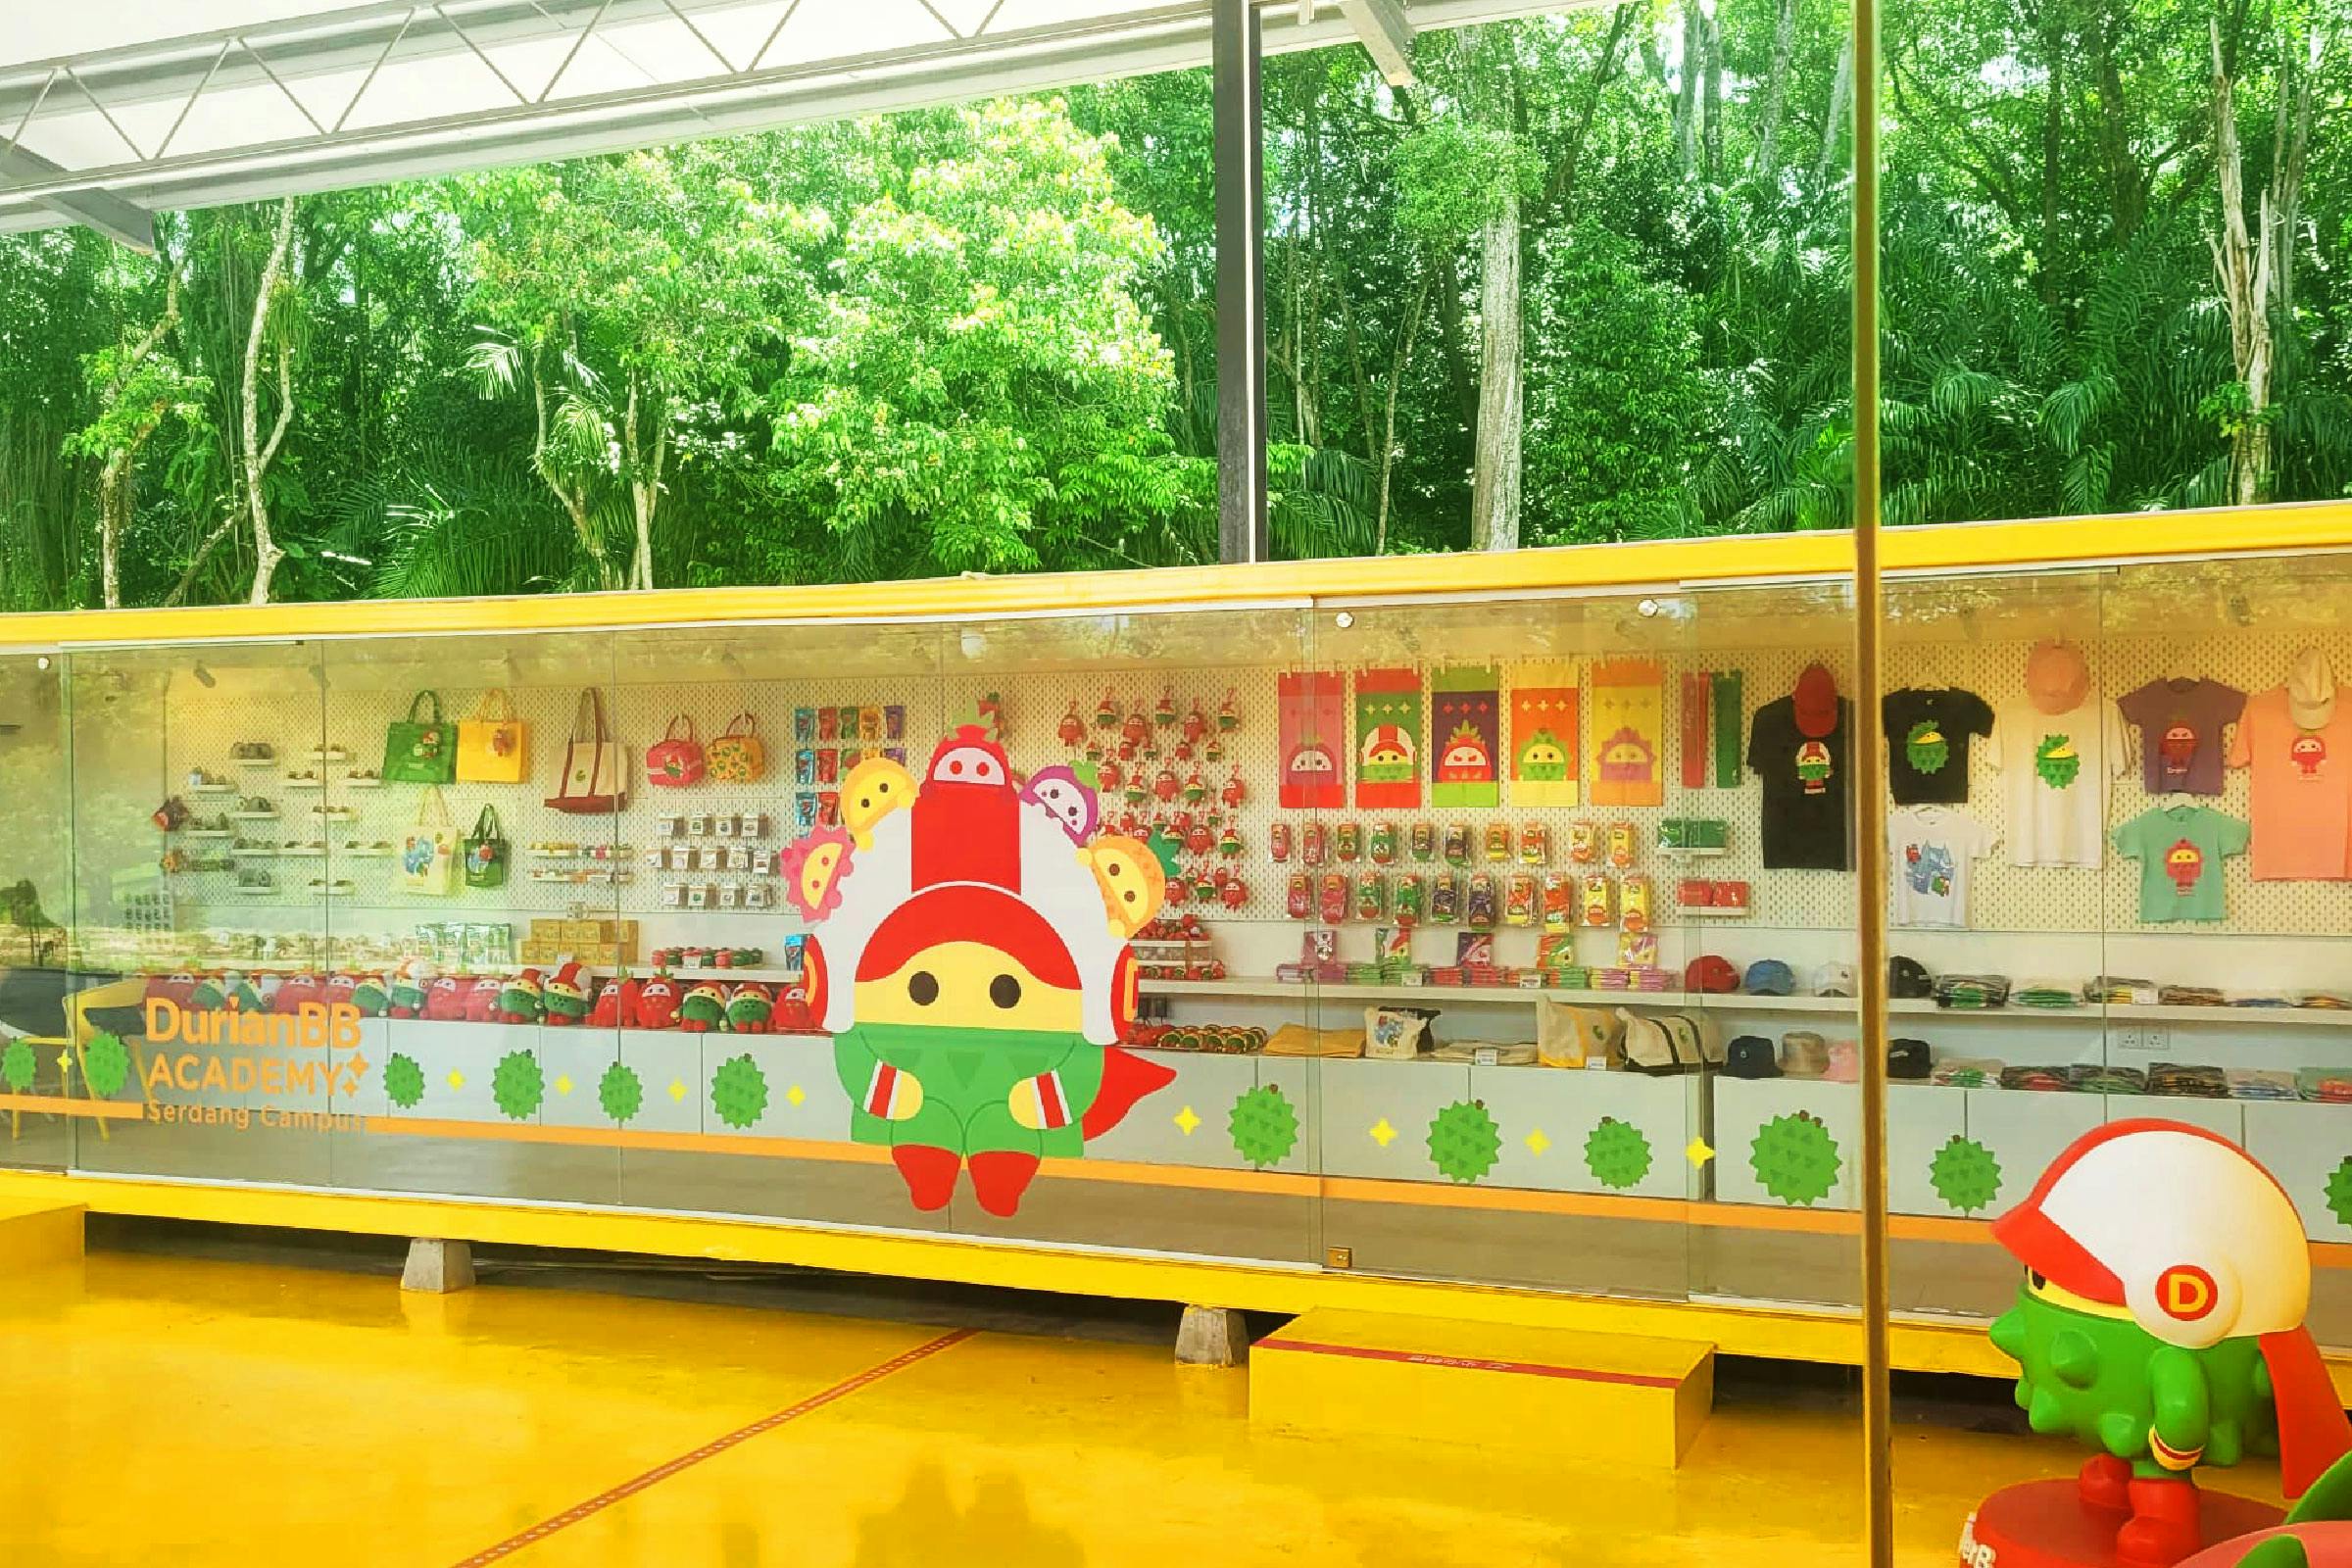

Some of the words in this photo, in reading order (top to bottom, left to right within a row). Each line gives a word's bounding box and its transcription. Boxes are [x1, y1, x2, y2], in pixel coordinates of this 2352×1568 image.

[146, 996, 361, 1049] DurianBB
[149, 1053, 343, 1097] ACADEMY
[148, 1099, 250, 1129] Serdang
[2168, 1273, 2208, 1312] D
